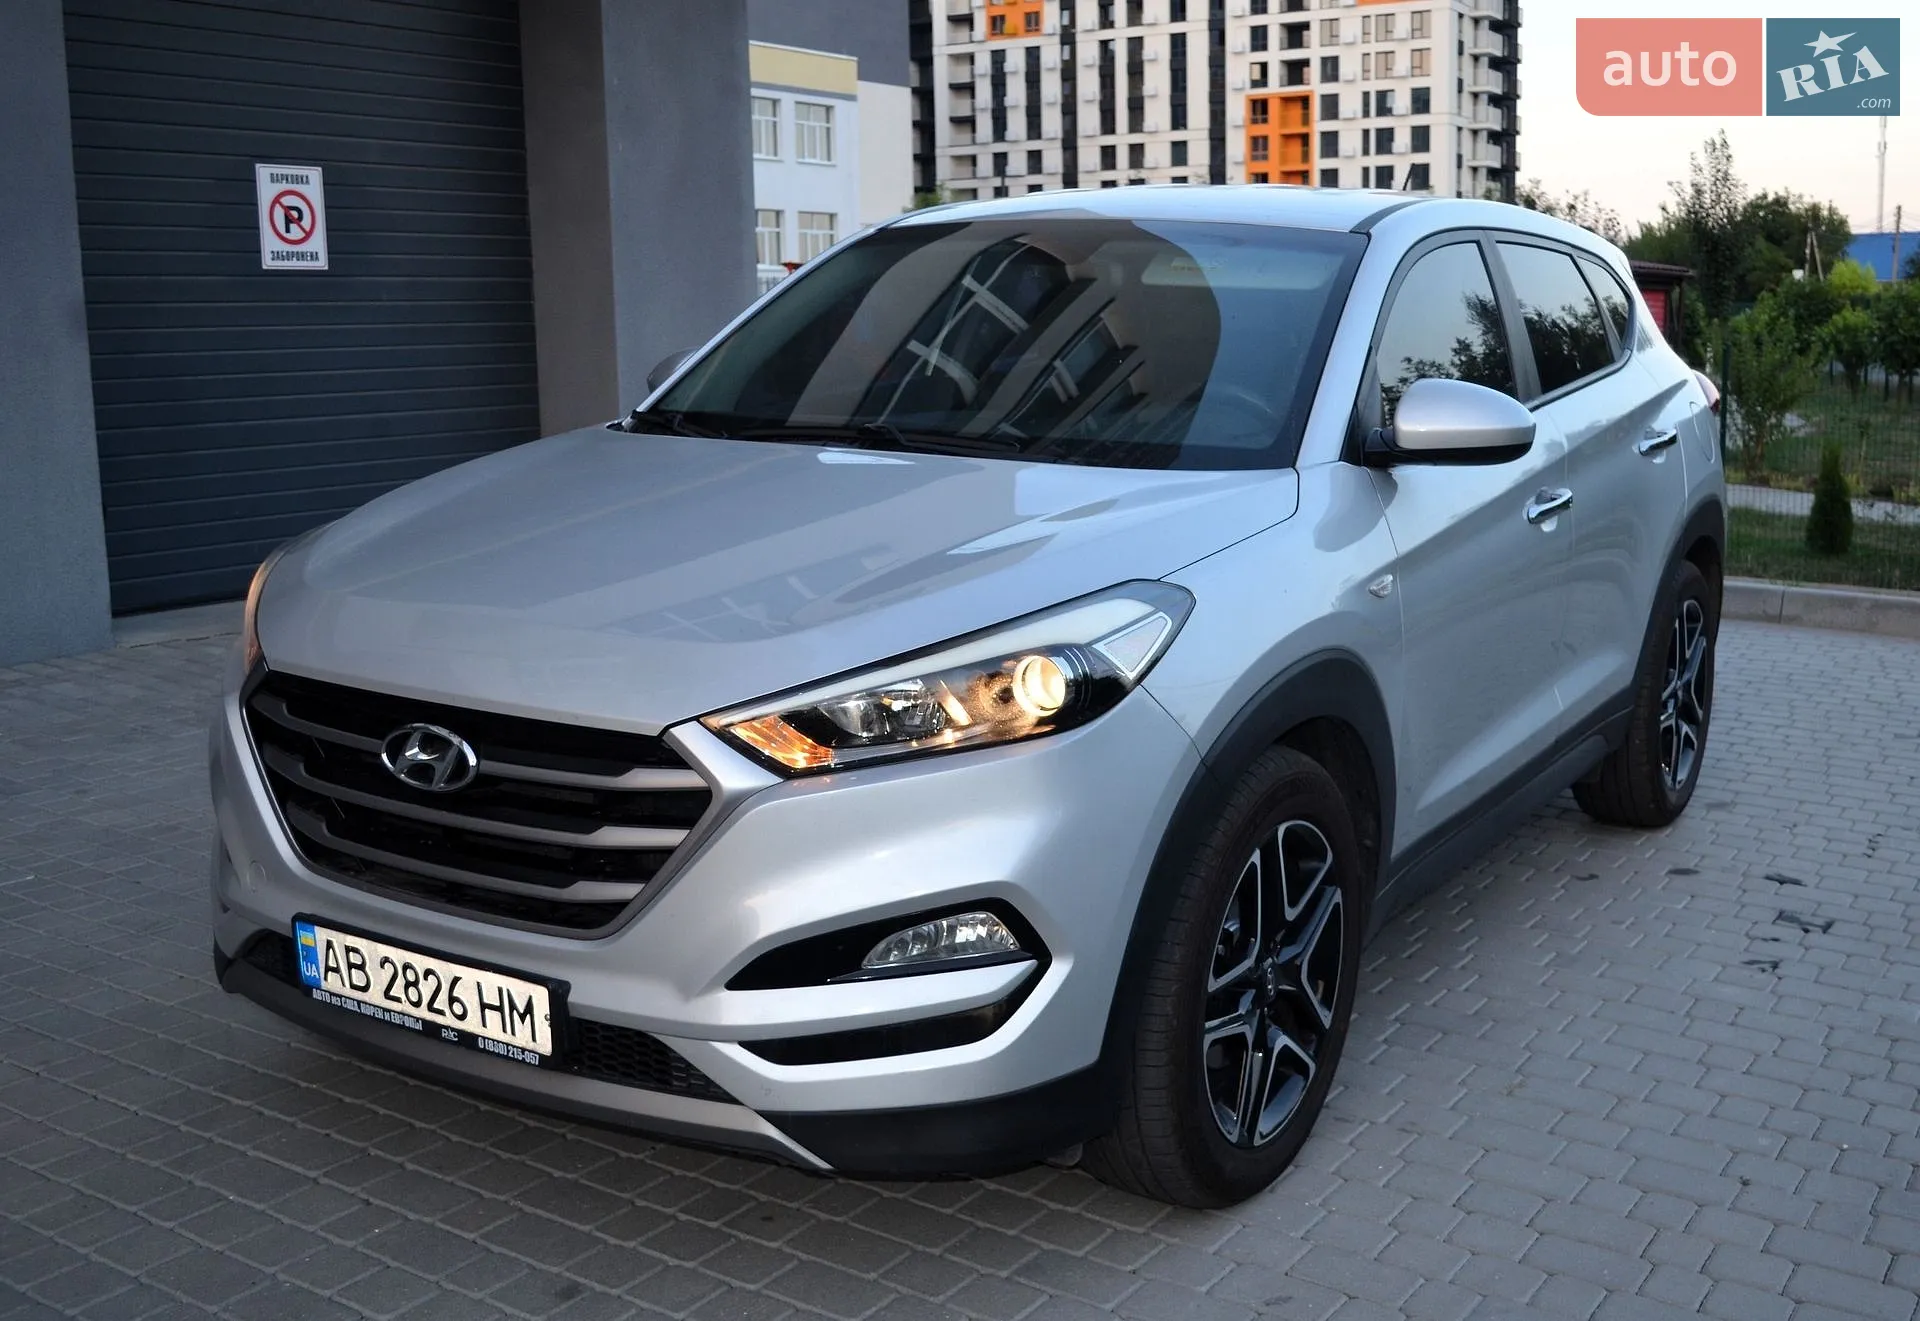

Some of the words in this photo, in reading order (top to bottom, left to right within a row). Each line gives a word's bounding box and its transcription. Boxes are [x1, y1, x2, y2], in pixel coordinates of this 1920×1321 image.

[270, 173, 311, 185] ПАРКОВКА
[270, 250, 320, 262] ЗАБОРОНЕНА
[303, 961, 319, 979] UA
[323, 938, 372, 993] AB
[379, 956, 469, 1021] 2826
[476, 981, 538, 1043] HM
[312, 988, 331, 1003] АВТО
[391, 1012, 423, 1031] ЕВРОПЫ
